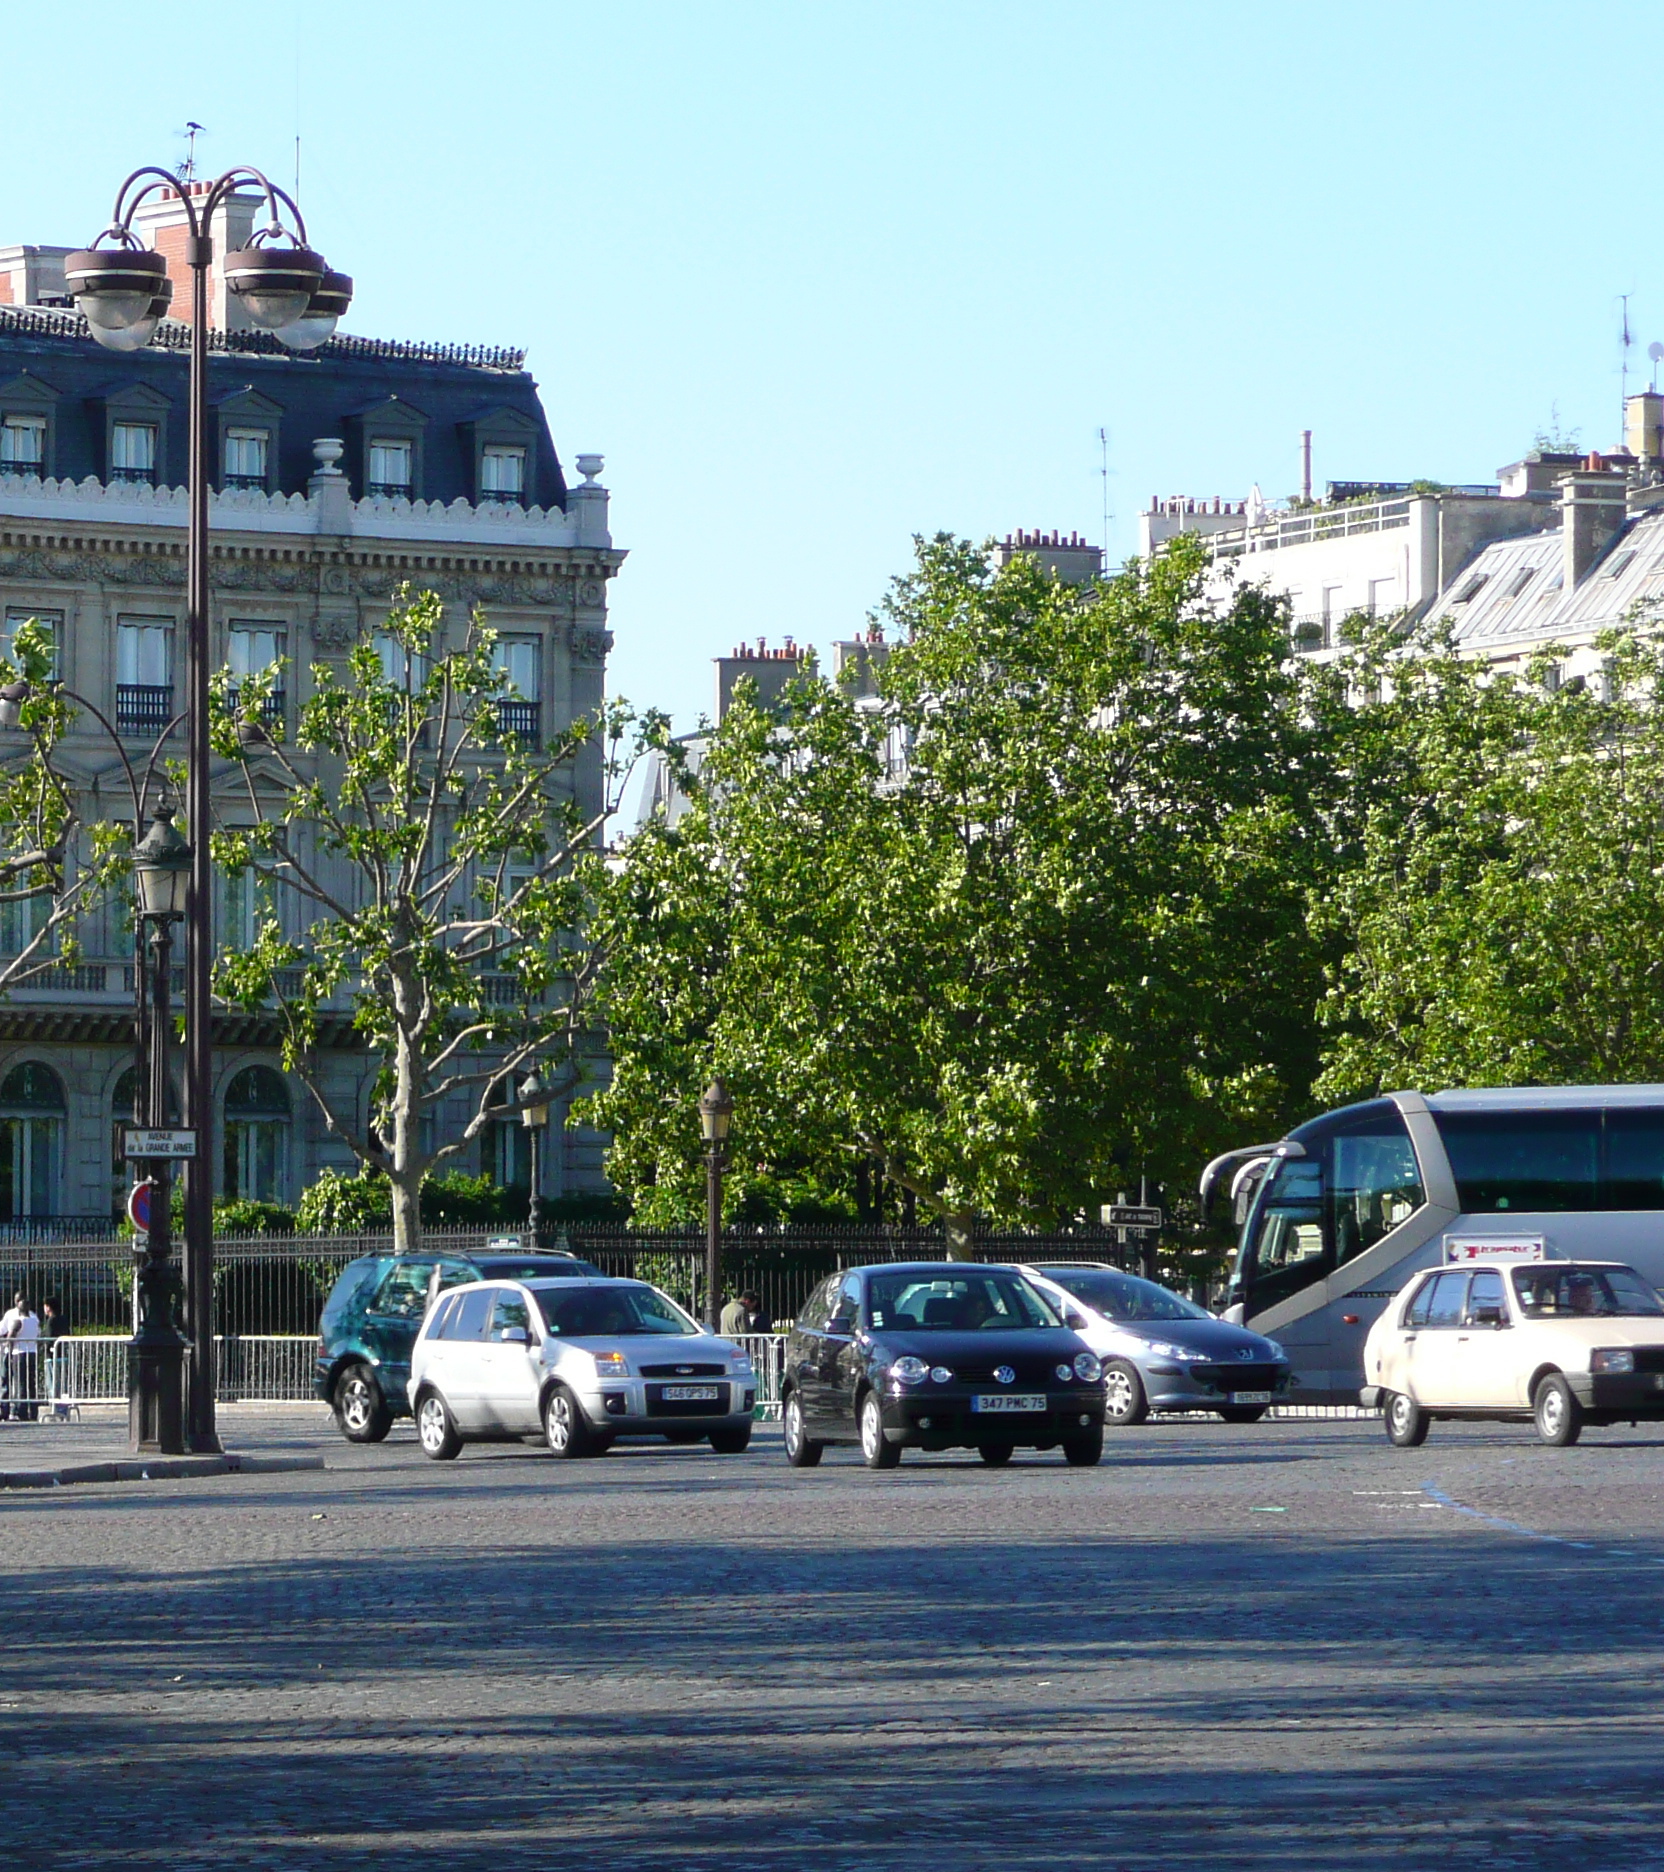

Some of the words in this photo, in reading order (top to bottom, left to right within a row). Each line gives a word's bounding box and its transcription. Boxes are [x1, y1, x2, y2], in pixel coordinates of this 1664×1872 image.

[147, 1132, 173, 1141] AVENUE
[146, 1143, 170, 1152] GRANDE
[982, 1397, 1003, 1409] 347
[1007, 1397, 1028, 1409] PMC
[1031, 1397, 1045, 1408] 75
